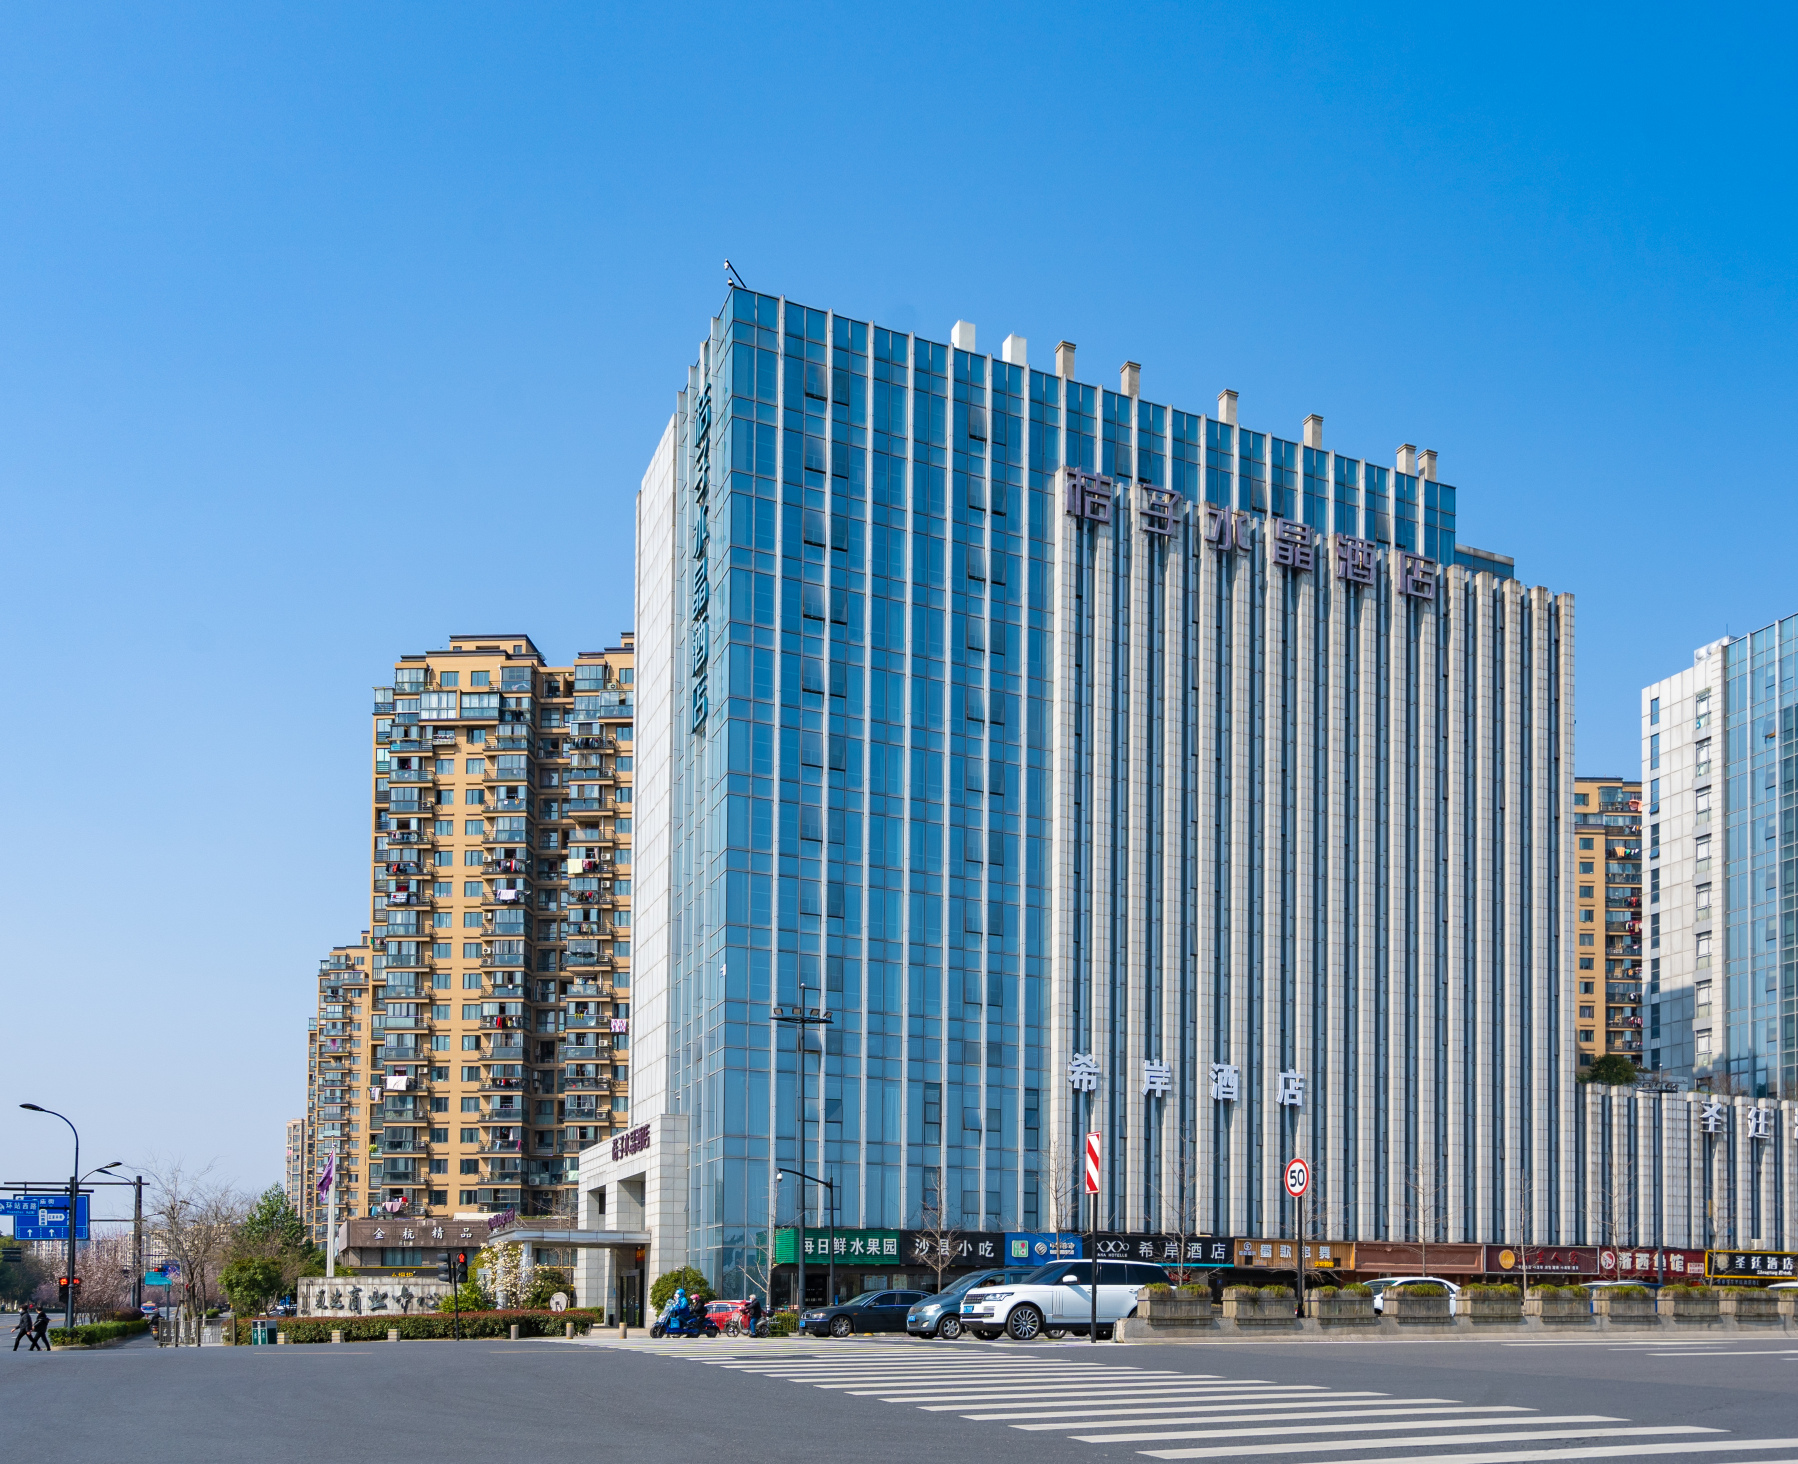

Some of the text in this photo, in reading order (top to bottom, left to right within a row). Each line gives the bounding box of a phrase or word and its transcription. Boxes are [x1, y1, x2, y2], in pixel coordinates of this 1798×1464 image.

[1066, 467, 1437, 600] 桔子水晶酒店
[1066, 1053, 1306, 1107] 希岸酒店
[1699, 1100, 1798, 1140] 圣廷
[1290, 1169, 1305, 1187] 50
[5, 1201, 37, 1210] 环站西路
[805, 1237, 897, 1256] 每日鲜水果园
[914, 1238, 995, 1258] 沙县小吃
[1138, 1241, 1226, 1260] 希岸酒店
[1618, 1251, 1684, 1273] 浙西鱼馆
[1735, 1255, 1794, 1270] 圣廷酒店
